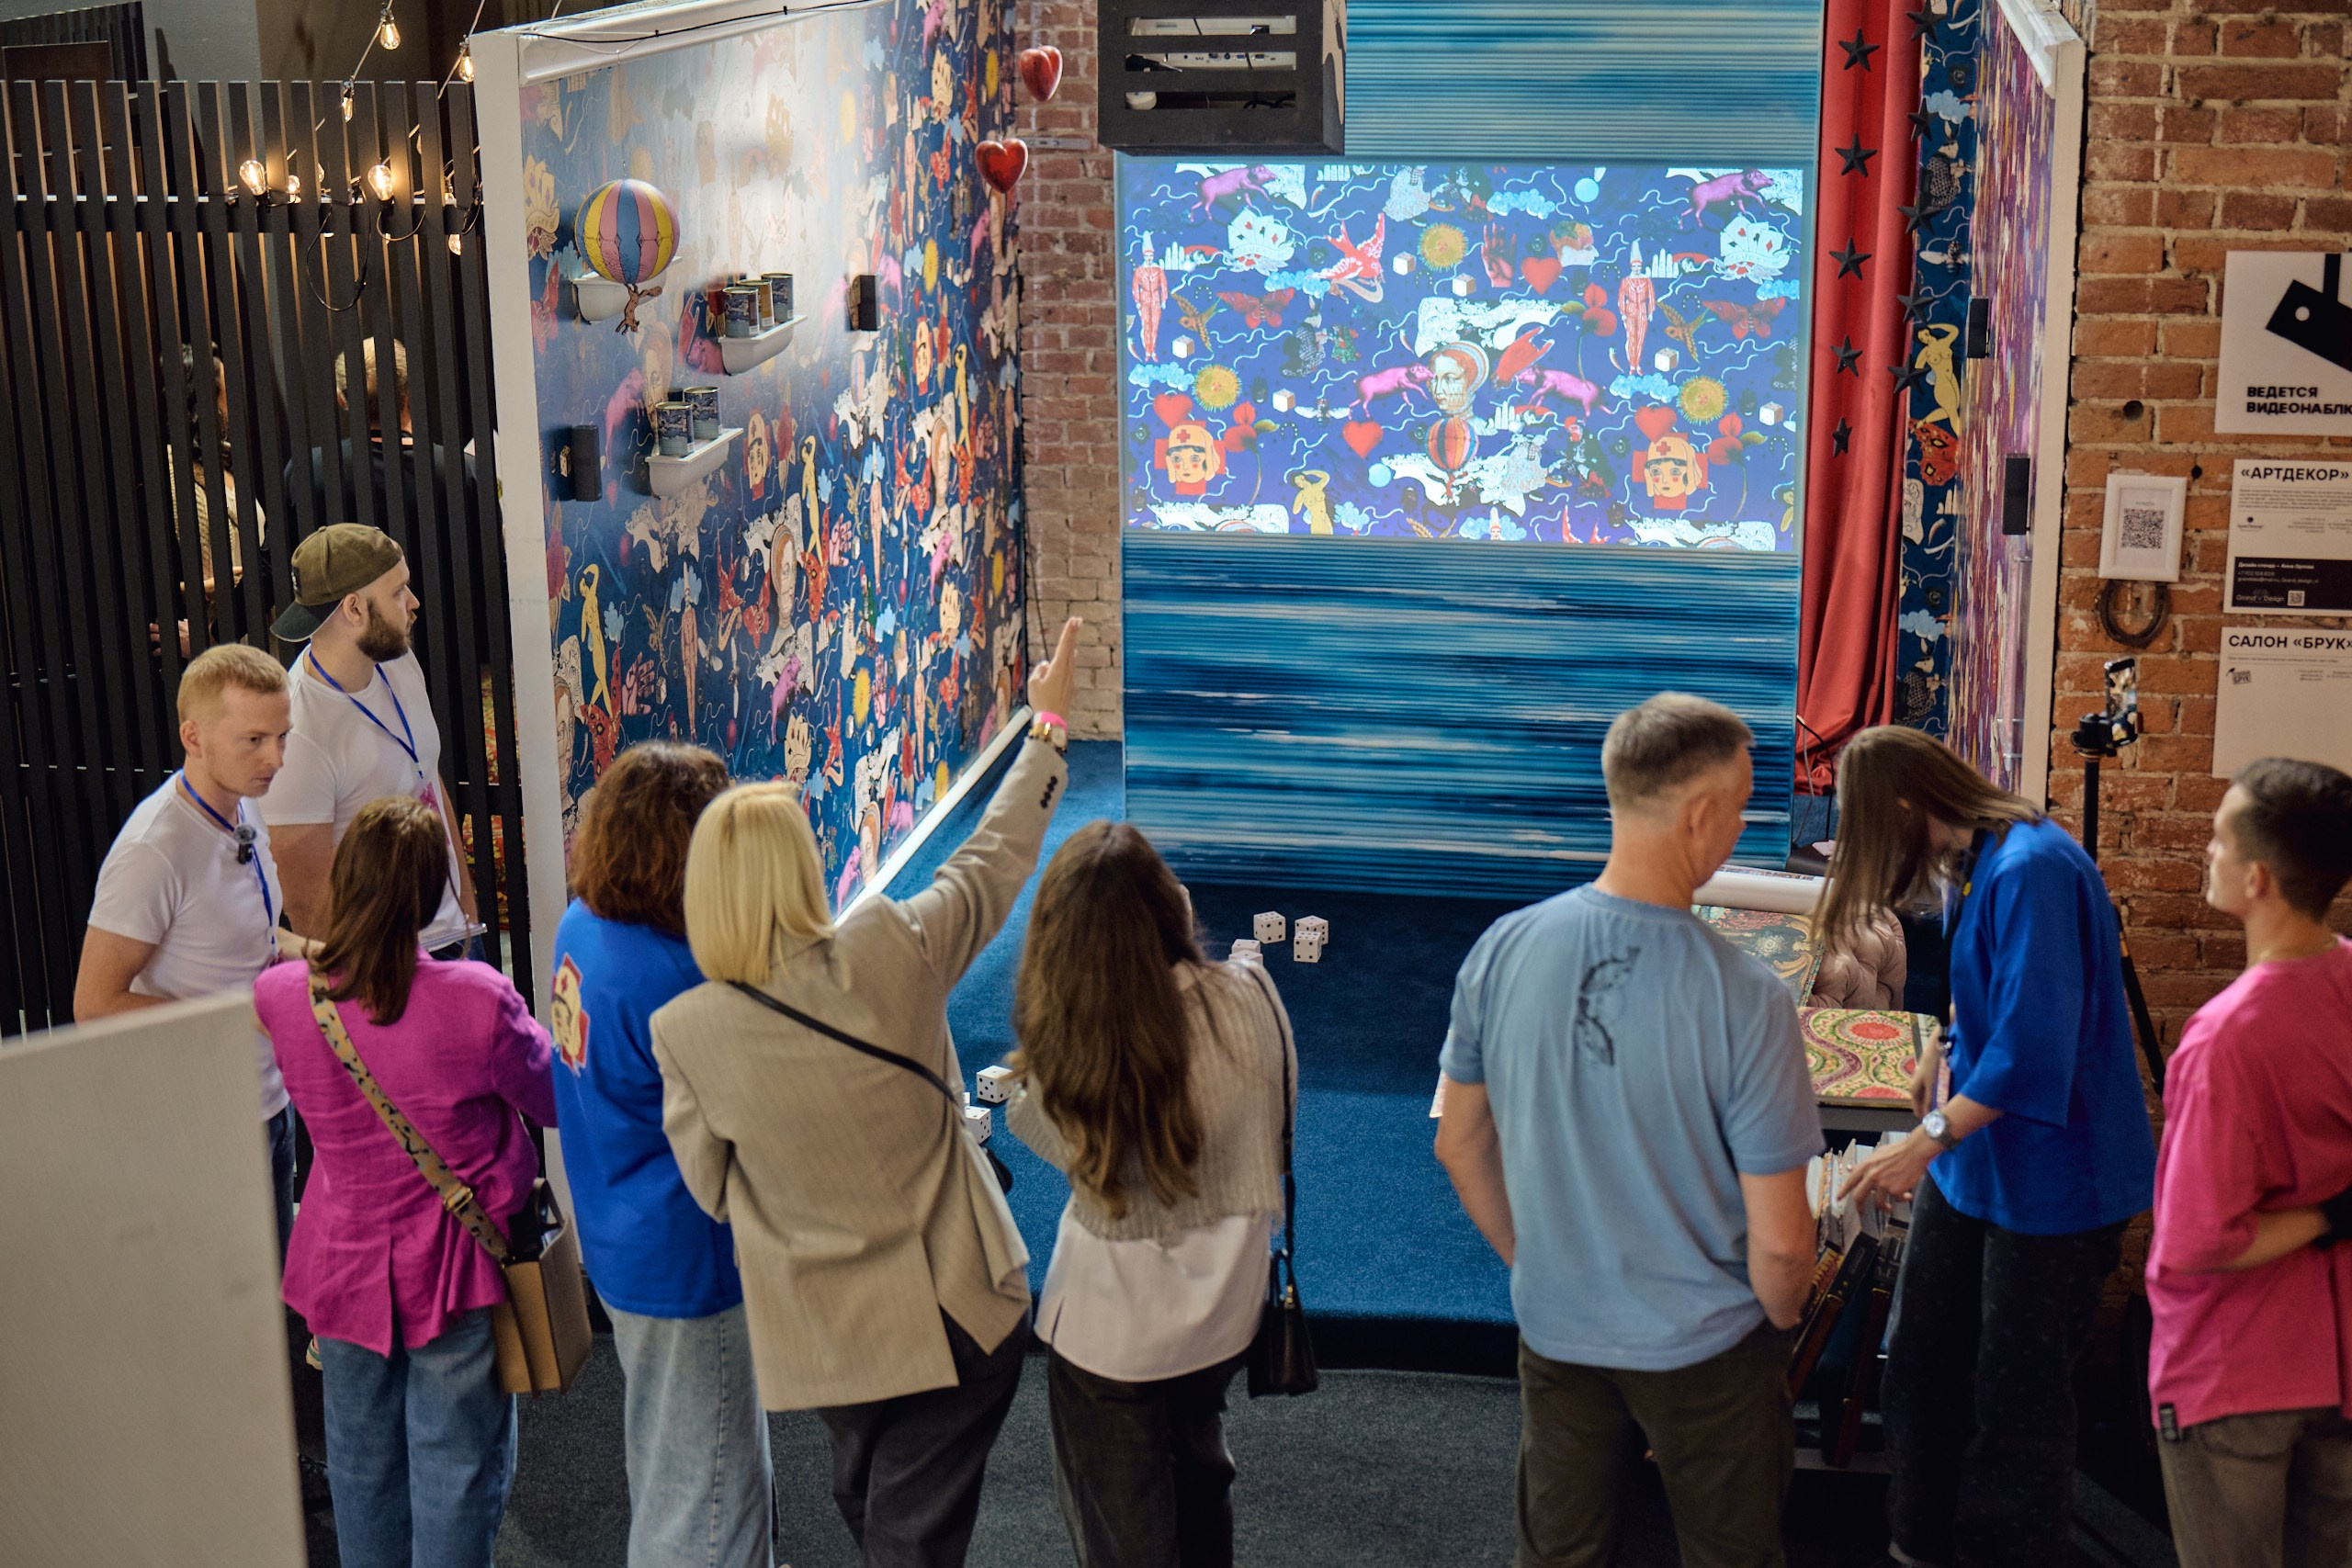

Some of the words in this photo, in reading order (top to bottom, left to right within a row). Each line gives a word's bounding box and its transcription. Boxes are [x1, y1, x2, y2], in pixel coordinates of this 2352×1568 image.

[2247, 387, 2318, 398] ВЕДЕТСЯ
[2241, 467, 2349, 482] «АРТДЕКОР»
[2228, 635, 2288, 648] САЛОН
